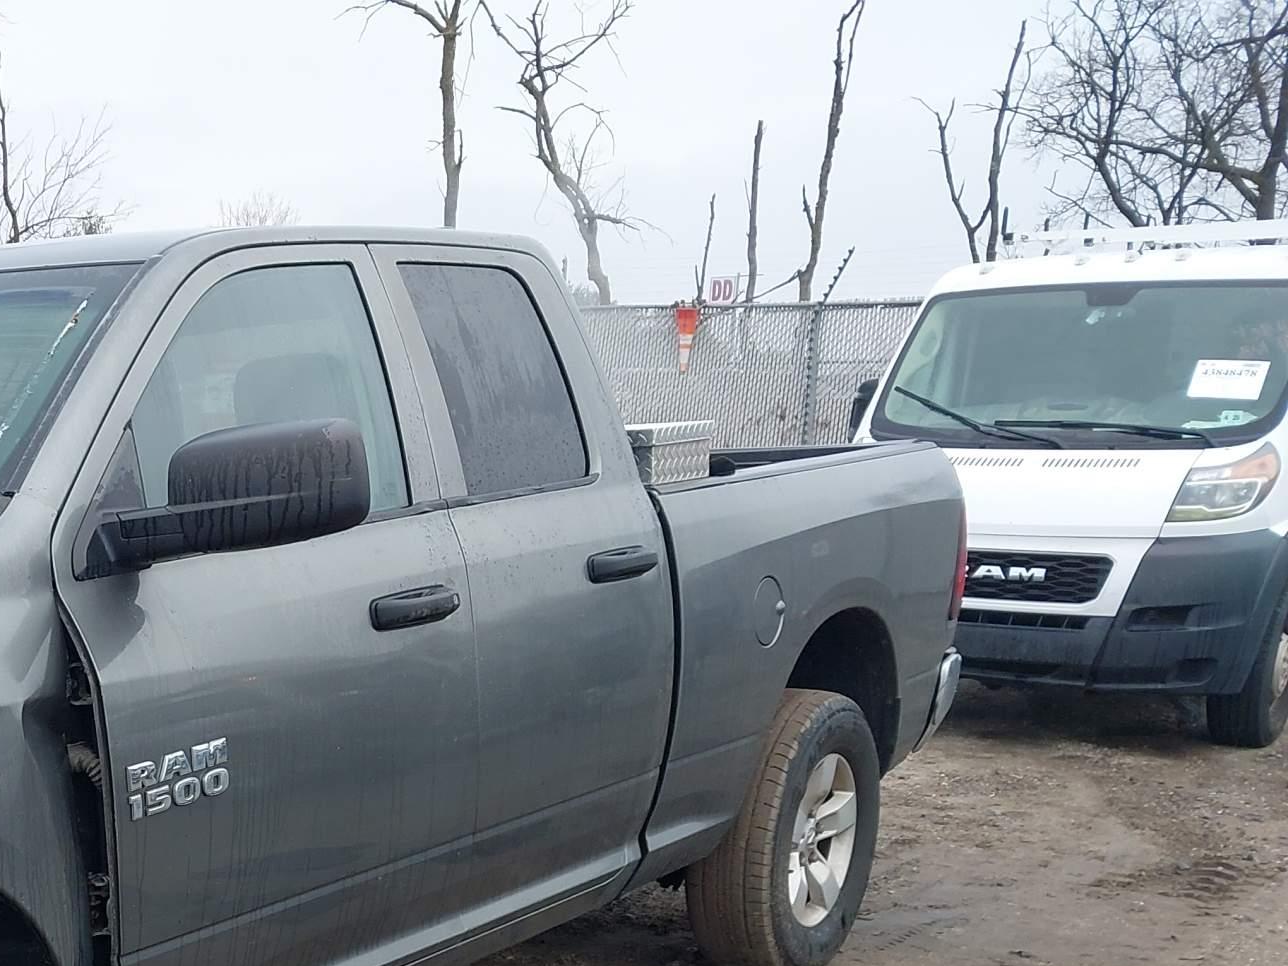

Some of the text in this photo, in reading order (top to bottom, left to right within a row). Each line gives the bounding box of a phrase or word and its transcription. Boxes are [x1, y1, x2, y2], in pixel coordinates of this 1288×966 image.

[712, 279, 733, 301] DD
[964, 564, 1047, 582] AM
[126, 737, 228, 793] RAM
[128, 767, 230, 821] 1500
